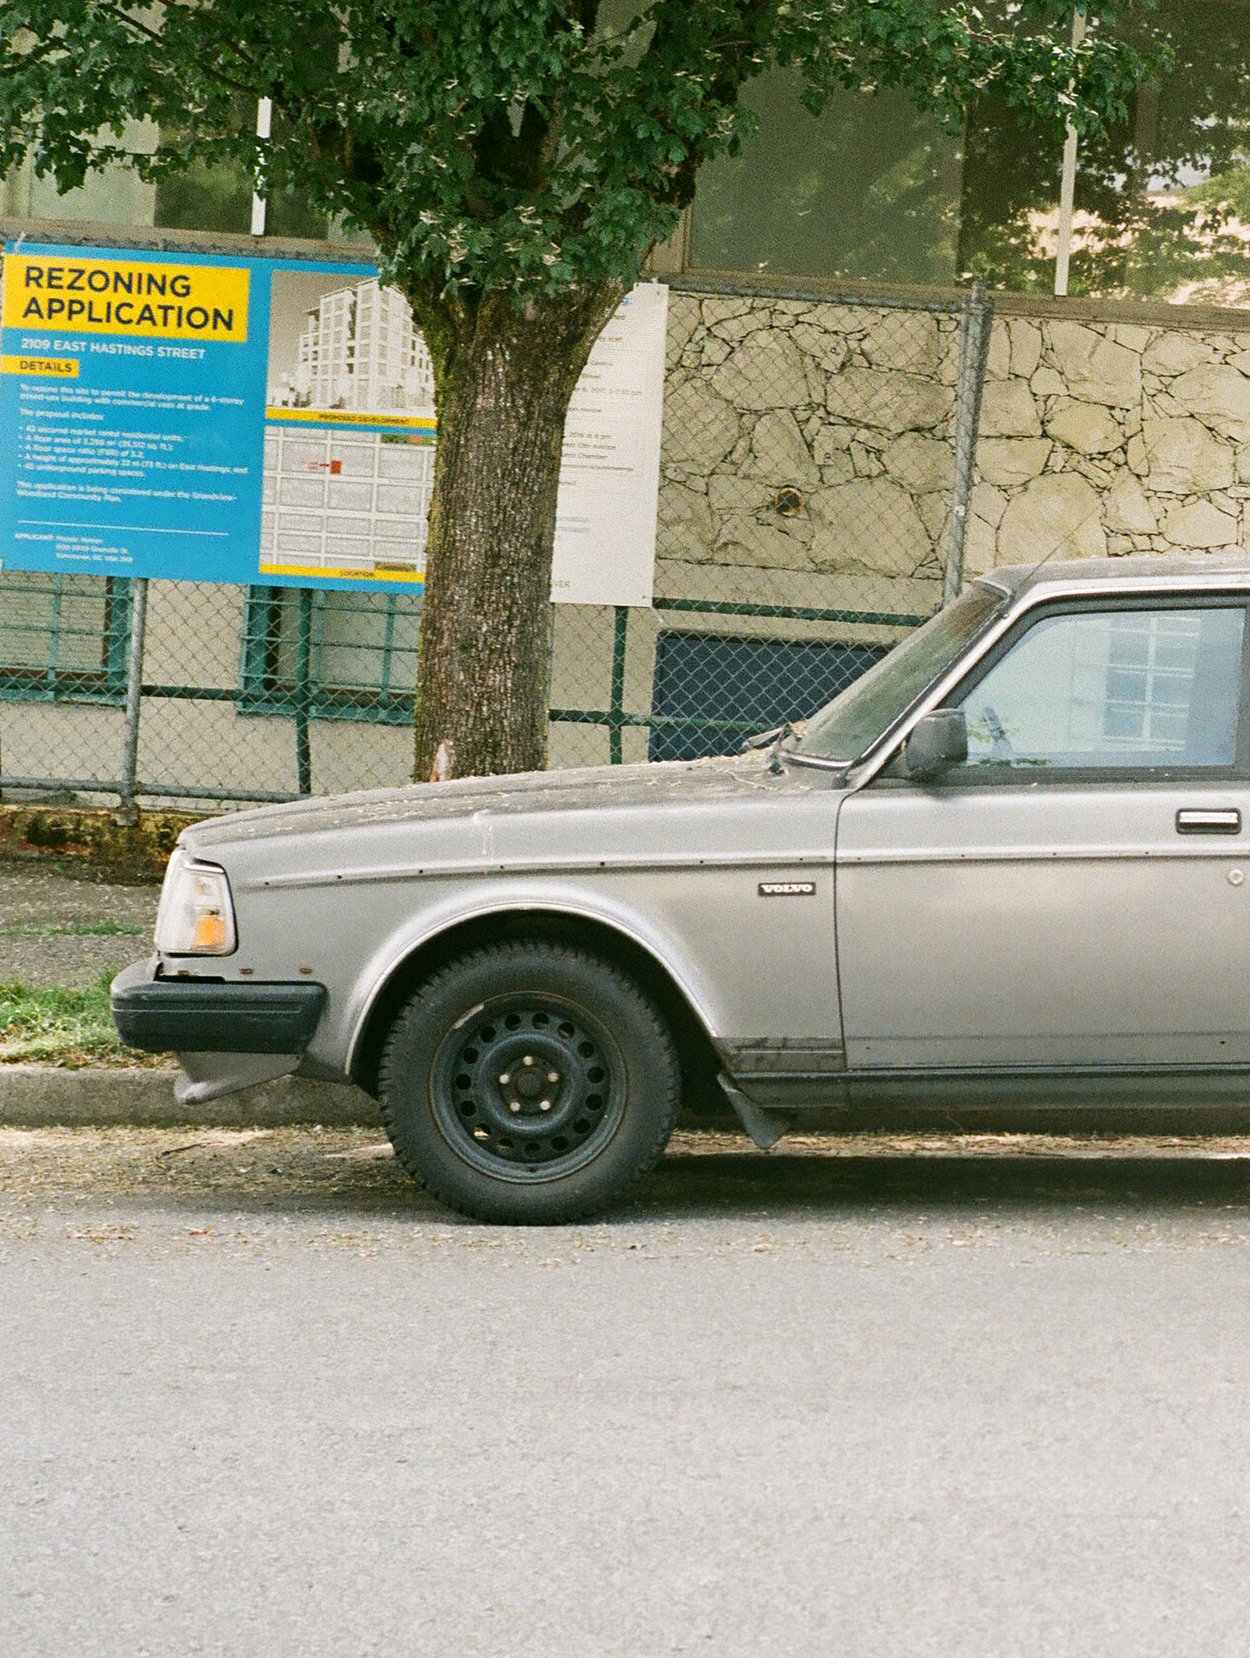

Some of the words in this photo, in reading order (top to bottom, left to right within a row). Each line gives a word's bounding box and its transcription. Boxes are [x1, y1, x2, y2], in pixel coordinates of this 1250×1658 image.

[24, 266, 191, 298] REZONING
[22, 296, 233, 331] APPLICATION
[21, 338, 51, 349] 2109
[53, 340, 87, 352] EAST
[90, 342, 153, 356] HASTINGS
[157, 346, 206, 359] STREET
[19, 360, 72, 372] DETAILS
[760, 884, 813, 893] VOLVO
